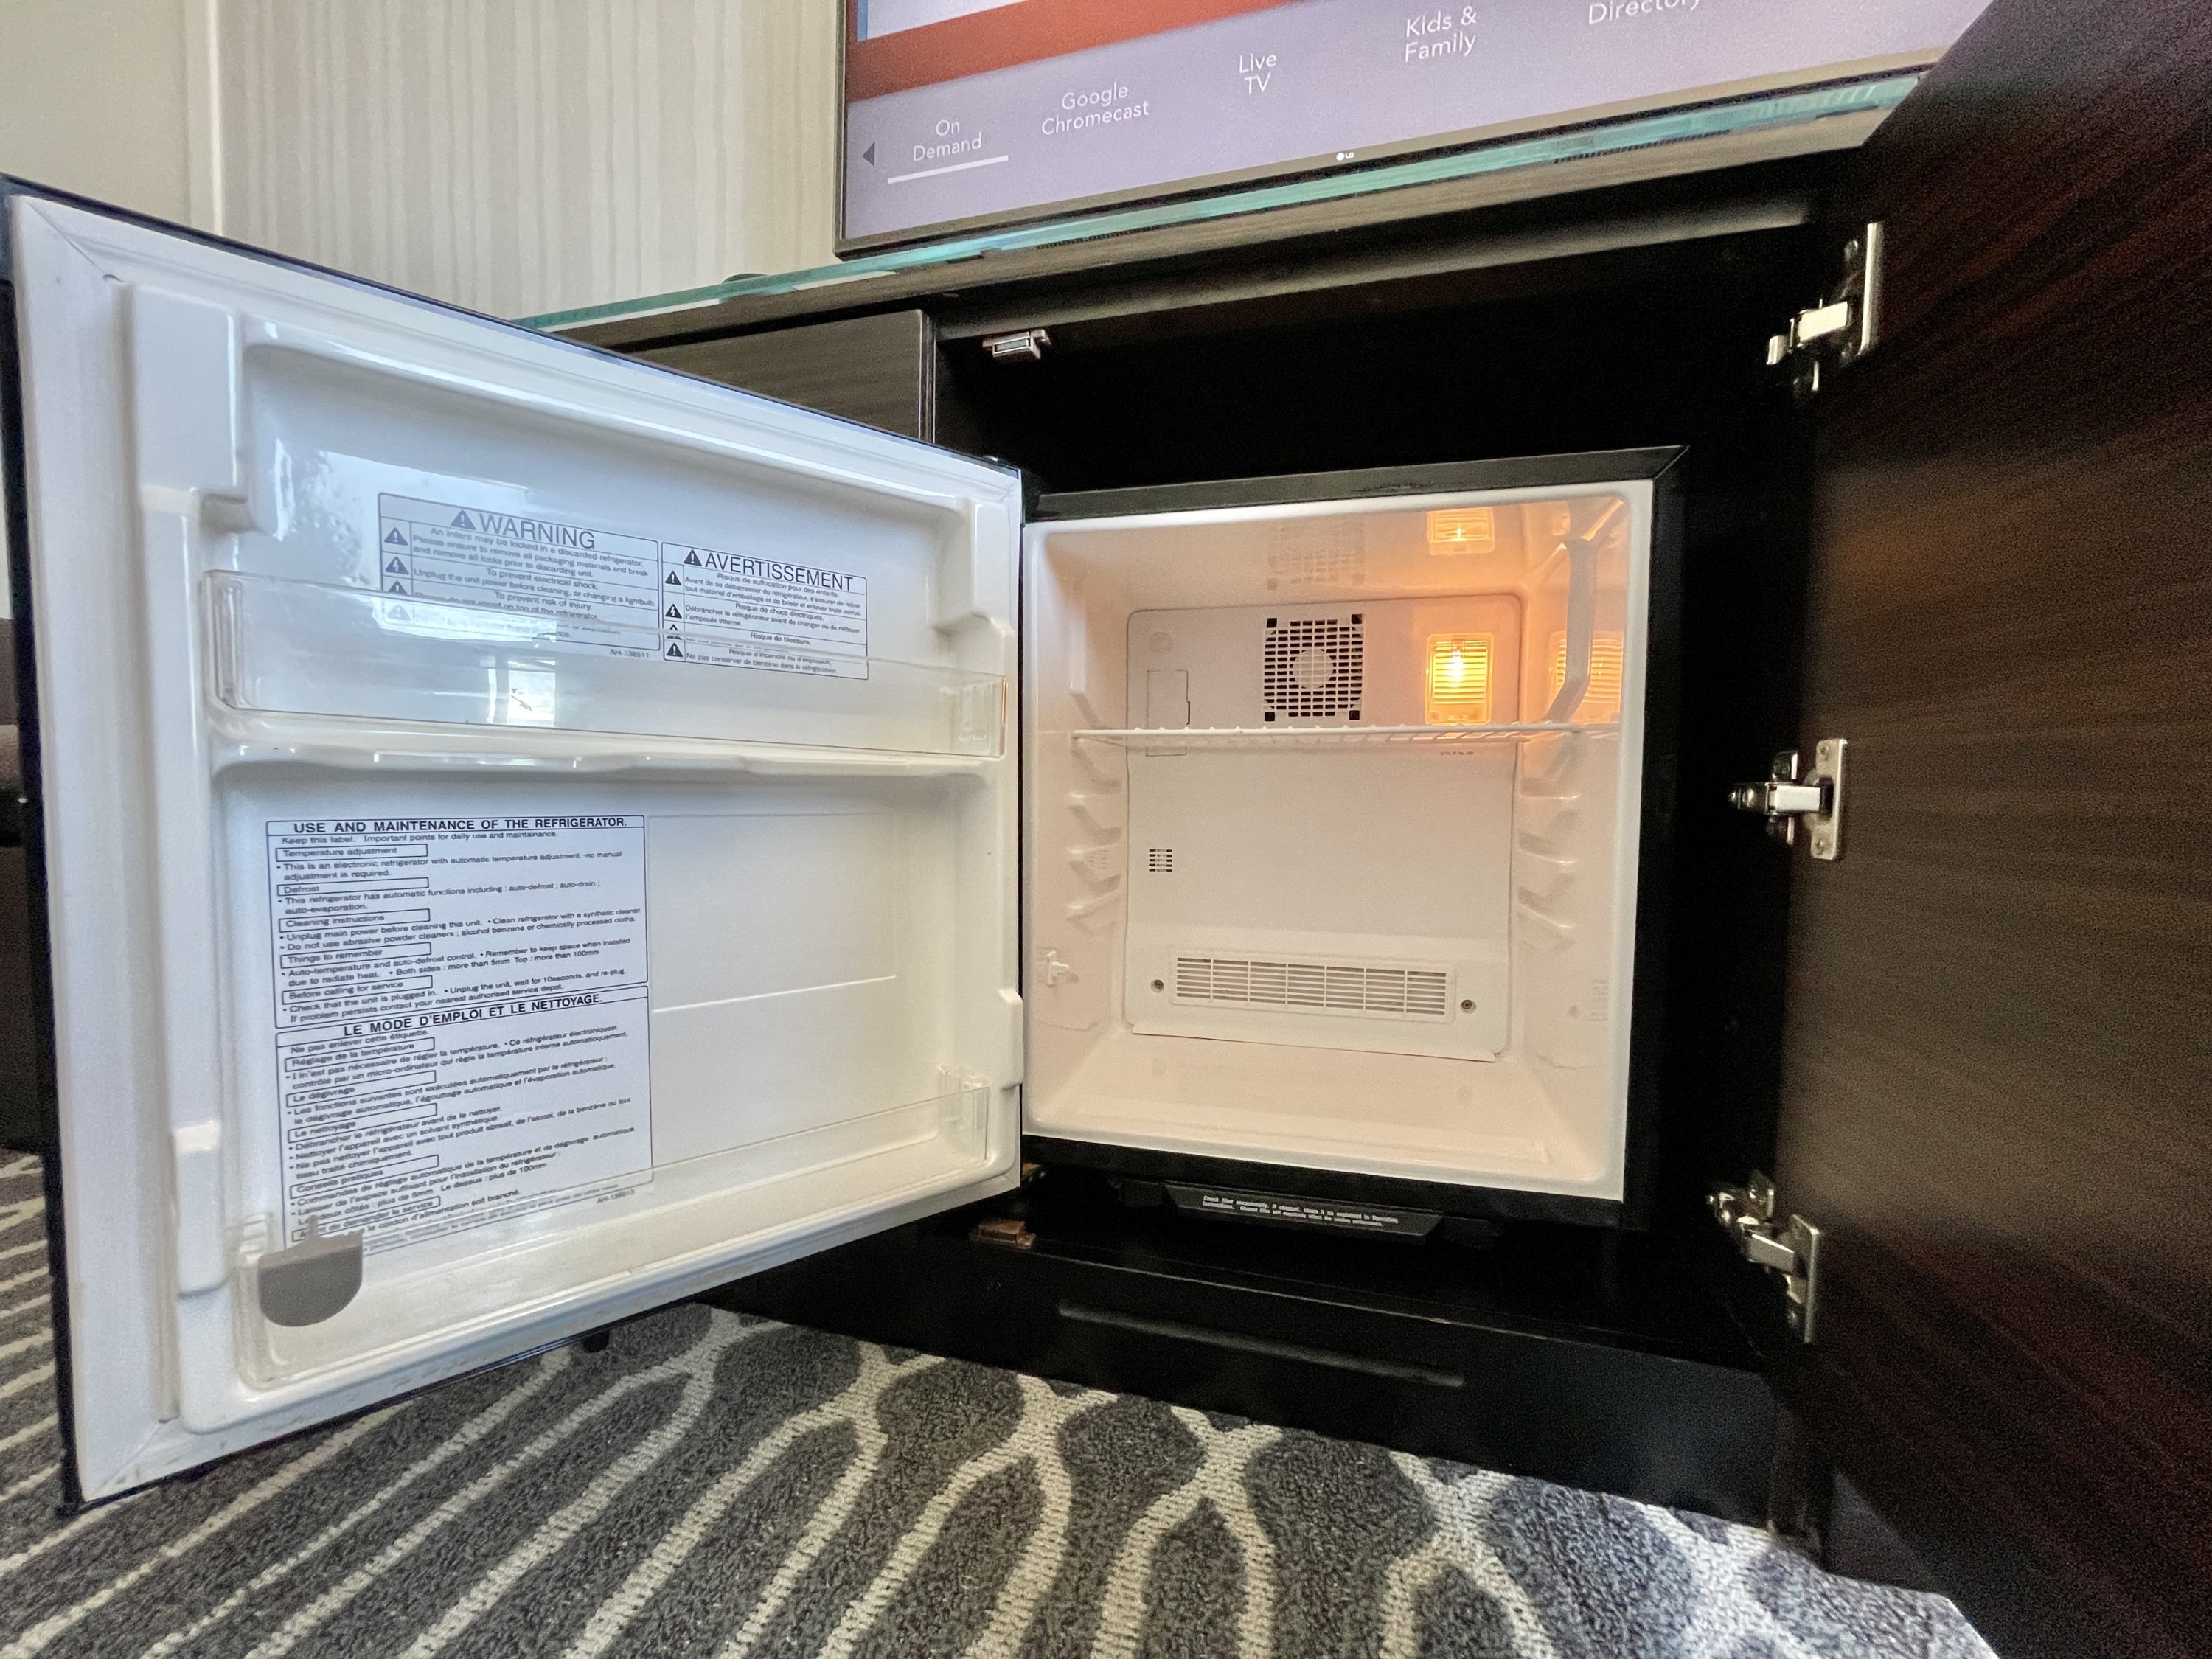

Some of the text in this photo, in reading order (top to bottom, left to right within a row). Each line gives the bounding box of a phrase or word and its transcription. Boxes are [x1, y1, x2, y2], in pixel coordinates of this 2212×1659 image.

[1406, 5, 1477, 38] Kids &
[1405, 31, 1476, 63] Family
[1239, 52, 1277, 73] Live
[1245, 72, 1271, 94] TV
[1062, 81, 1128, 110] Google
[936, 119, 960, 136] On
[1042, 100, 1150, 135] Chromecast
[913, 131, 982, 161] Demand
[479, 512, 594, 549] WARNING
[705, 552, 852, 591] AVERTISSEMENT
[293, 817, 626, 833] USE AND MAINTENANCE OF THE REFRIGERATOR.
[364, 835, 407, 843] Important
[409, 834, 435, 842] points
[347, 847, 397, 856] adjustment
[380, 859, 428, 867] refrigerator
[284, 872, 337, 881] adjustment
[283, 886, 319, 894] Defrost
[285, 915, 384, 928] Cleaning instructions
[286, 932, 321, 941] Unplug
[350, 928, 378, 937] power
[411, 922, 446, 931] cleaning
[518, 914, 558, 922] refrigerator
[583, 910, 613, 918] synthetic
[288, 955, 320, 963] Things
[335, 950, 382, 959] remember
[321, 974, 354, 983] radiate
[395, 967, 416, 975] Both
[288, 991, 321, 1000] Before
[324, 987, 354, 995] calling
[371, 981, 403, 990] service
[289, 1004, 320, 1012] Check
[323, 1001, 341, 1009] that
[361, 996, 378, 1004] unit
[390, 990, 425, 1002] plugged
[450, 985, 479, 993] Unplug
[344, 993, 602, 1036] LE MODE D'EMPLOI ET LE NETTOYAGE.
